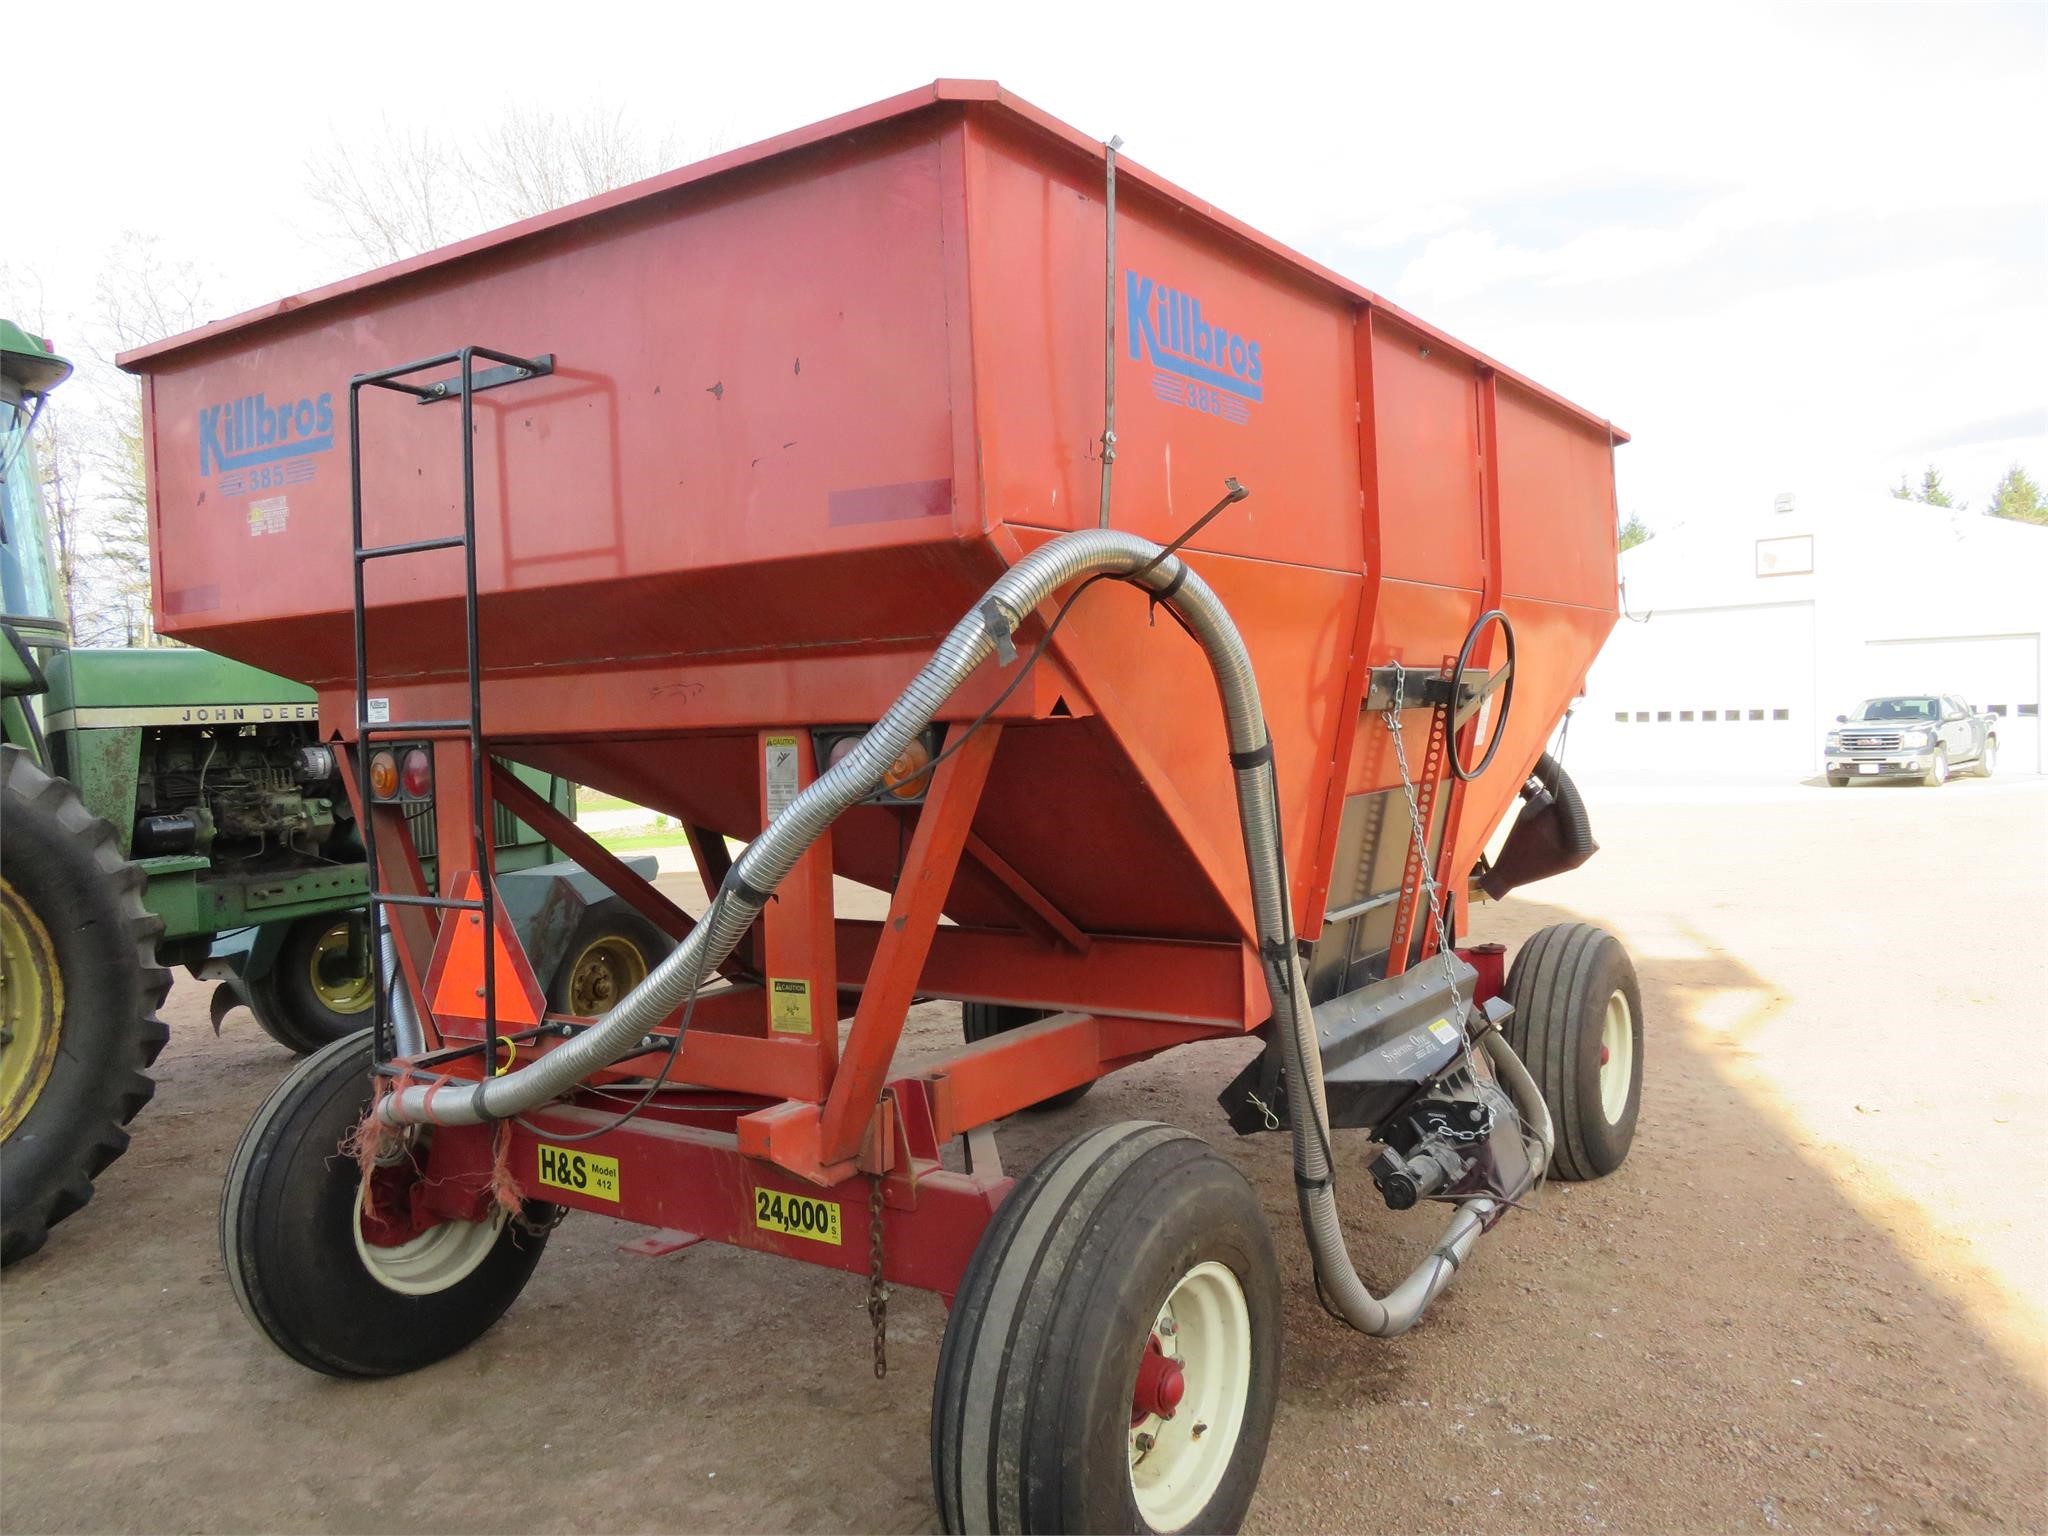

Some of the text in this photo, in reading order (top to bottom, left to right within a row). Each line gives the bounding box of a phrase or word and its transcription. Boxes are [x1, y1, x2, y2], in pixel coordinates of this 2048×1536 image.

[1126, 269, 1262, 388] Killbros
[1185, 383, 1222, 416] 385
[199, 392, 334, 477] Killbros
[250, 465, 284, 491] 385
[182, 707, 319, 721] JOHN DEER
[781, 983, 805, 993] CAUTION
[541, 1148, 616, 1189] H&S Model
[597, 1179, 612, 1190] 412
[758, 1191, 829, 1234] 24,000
